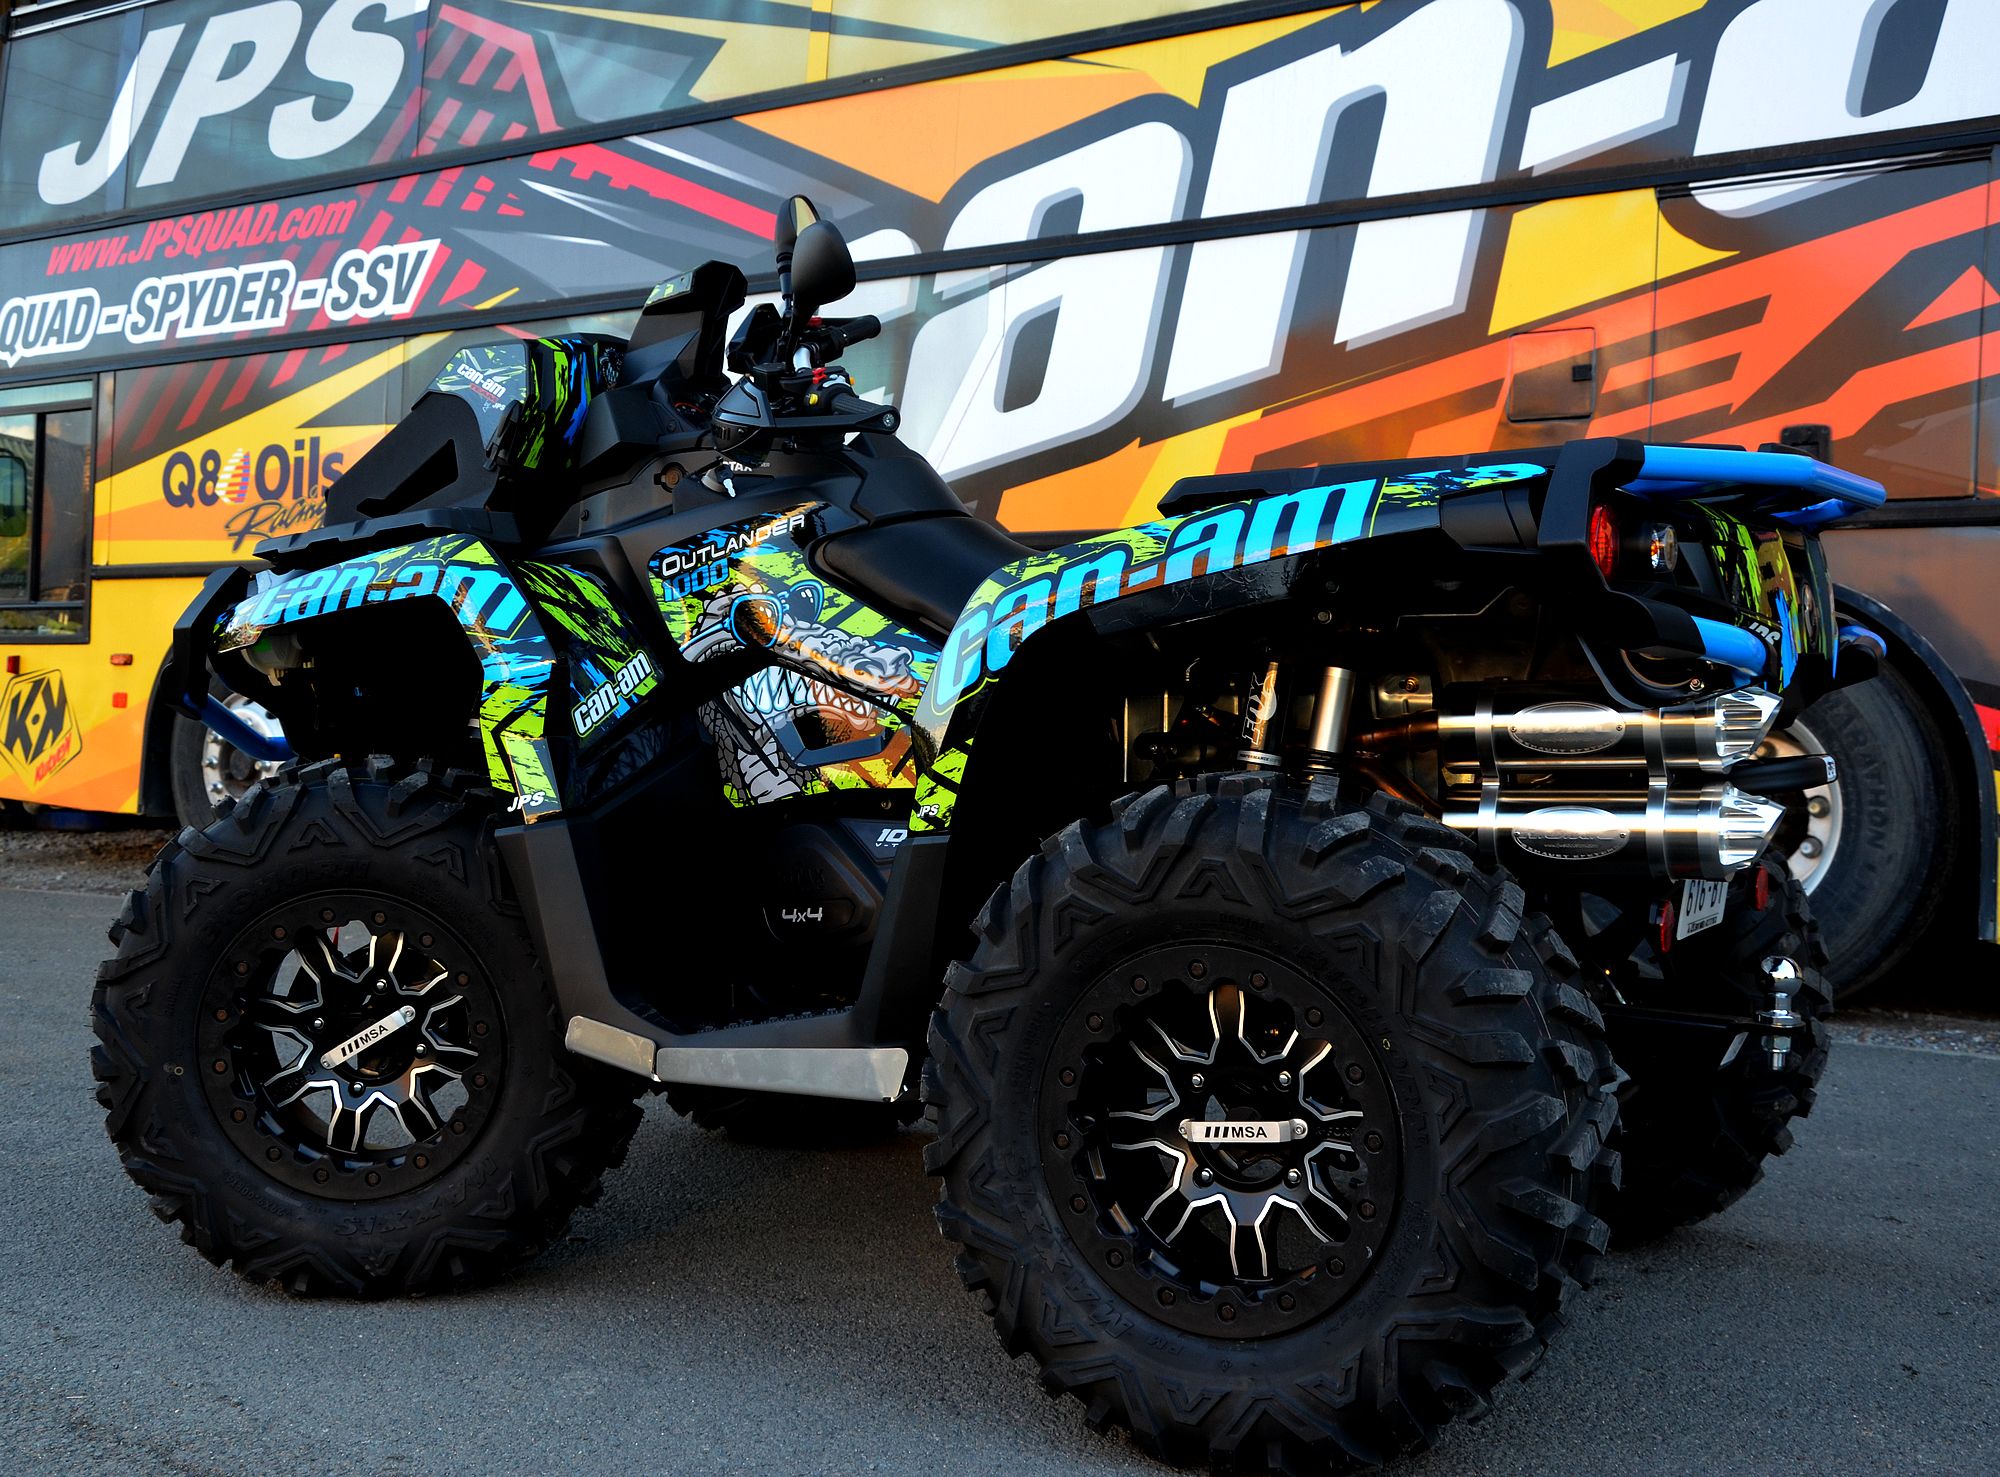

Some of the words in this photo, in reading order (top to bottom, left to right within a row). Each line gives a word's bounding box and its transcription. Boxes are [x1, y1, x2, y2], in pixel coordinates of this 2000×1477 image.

[38, 0, 431, 206] JPS
[45, 199, 359, 276] www.JPSQUAD.com
[457, 363, 506, 398] can-am
[162, 448, 222, 508] Q8
[254, 436, 344, 501] Oils
[662, 514, 806, 577] OUTLANDER
[249, 564, 527, 631] can-am
[663, 557, 730, 602] 1000
[936, 478, 1378, 707] can-am
[573, 652, 651, 735] can-am
[507, 791, 545, 812] JPS
[917, 804, 940, 818] JPS
[781, 907, 823, 922] 4x4
